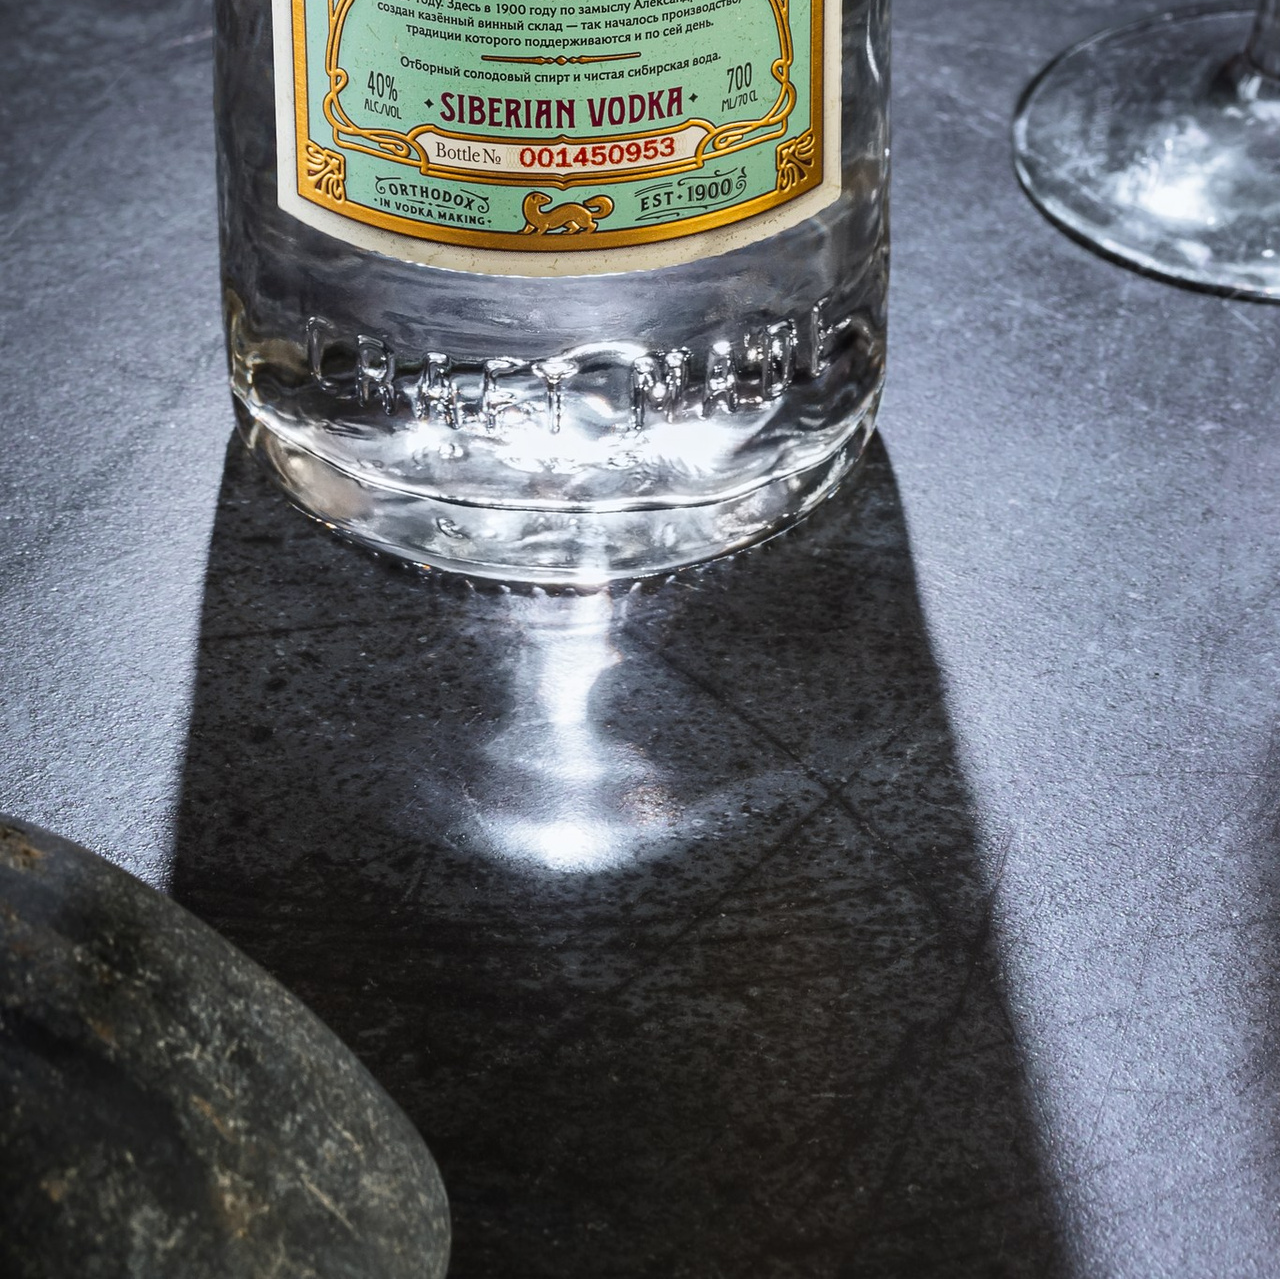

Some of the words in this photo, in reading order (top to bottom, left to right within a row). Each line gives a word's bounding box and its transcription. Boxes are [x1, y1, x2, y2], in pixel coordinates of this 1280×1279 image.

[378, 1, 415, 17] создан
[418, 10, 474, 27] казённый
[478, 20, 524, 31] винный
[528, 22, 563, 32] склад
[581, 22, 601, 30] так
[605, 15, 659, 28] началось
[484, 4, 491, 12] в
[496, 4, 526, 15] 1900
[529, 7, 556, 18] году
[560, 7, 575, 15] по
[579, 2, 631, 14] замыслу
[406, 24, 461, 41] традиции
[465, 35, 521, 47] которого
[525, 34, 631, 49] поддерживаются
[635, 33, 642, 41] и
[645, 30, 659, 39] по
[663, 26, 683, 37] сей
[685, 20, 714, 33] день.
[400, 56, 460, 77] Отборный
[464, 69, 531, 82] солодовый
[534, 73, 570, 85] спирт
[574, 74, 581, 82] и
[584, 71, 625, 81] чистая
[628, 61, 690, 77] сибирская
[692, 53, 721, 67] вода.
[726, 62, 752, 93] 700
[367, 71, 398, 102] 40%
[364, 98, 402, 119] ALC/VOL
[440, 92, 575, 128] SIBERIAN
[588, 87, 683, 127] VODKA
[721, 93, 747, 112] ML/70
[435, 142, 480, 162] Bottle
[519, 136, 675, 168] 001450953
[389, 183, 476, 211] ORTHODOX
[641, 191, 673, 212] EST
[687, 178, 732, 202] 1900
[380, 198, 390, 208] IN
[395, 202, 433, 217] VODKA
[438, 211, 485, 225] MAKING
